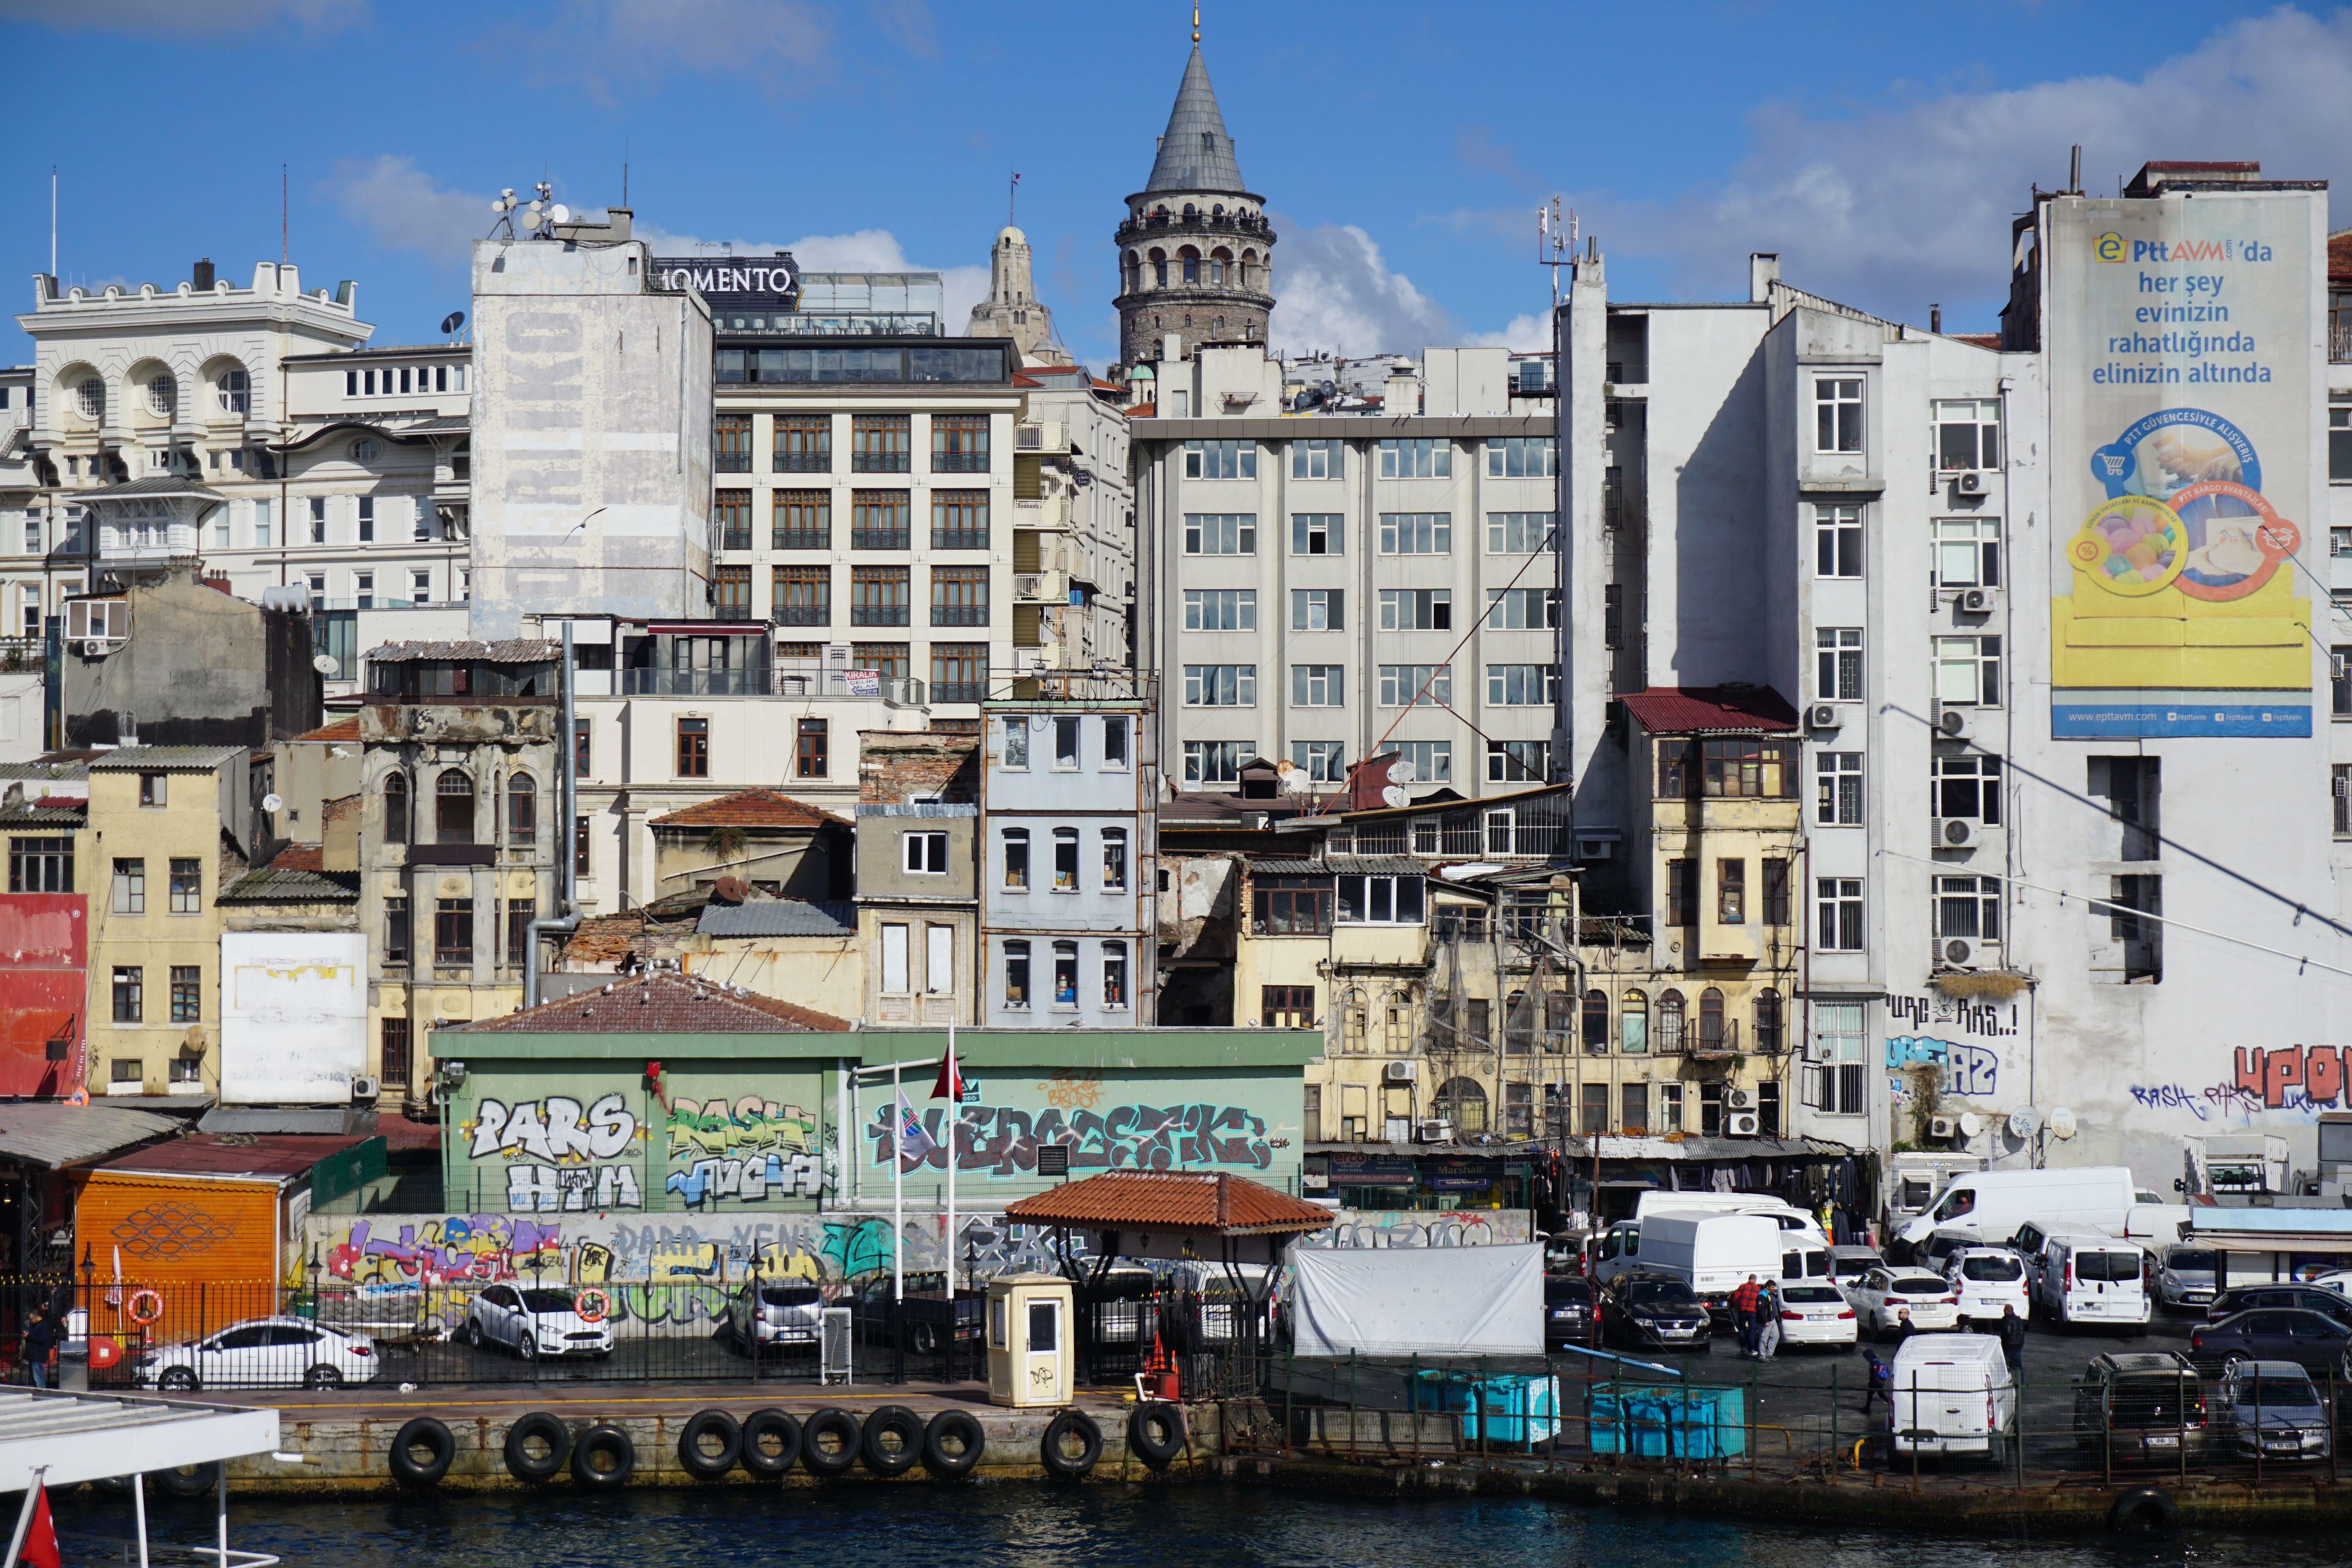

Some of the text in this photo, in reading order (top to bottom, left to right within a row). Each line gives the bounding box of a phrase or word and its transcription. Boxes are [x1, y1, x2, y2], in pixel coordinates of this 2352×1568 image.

[2139, 271, 2224, 297] her şey
[2136, 300, 2229, 323] evinizin
[2109, 331, 2255, 358] rahatlığında
[2092, 361, 2272, 384] elinizin altında
[2123, 411, 2254, 464] PTT GÜVENCESİYLE ALIŞVERİŞ
[2177, 484, 2270, 515] PTT KARGO AVANTAJLARI
[2086, 510, 2102, 529] GÜNÜN
[2100, 498, 2132, 513] FIRSATLARI
[2141, 499, 2179, 524] KAMPANYALAR
[2069, 712, 2157, 722] www.epttavm.com
[2178, 713, 2207, 722] /epttavm
[2225, 713, 2255, 722] /epttavm
[2274, 713, 2302, 722] /epttavm
[468, 1094, 635, 1165] PARS
[1335, 1154, 1365, 1162] erco
[1438, 1166, 1483, 1174] Marshall
[619, 1224, 699, 1256] DARA
